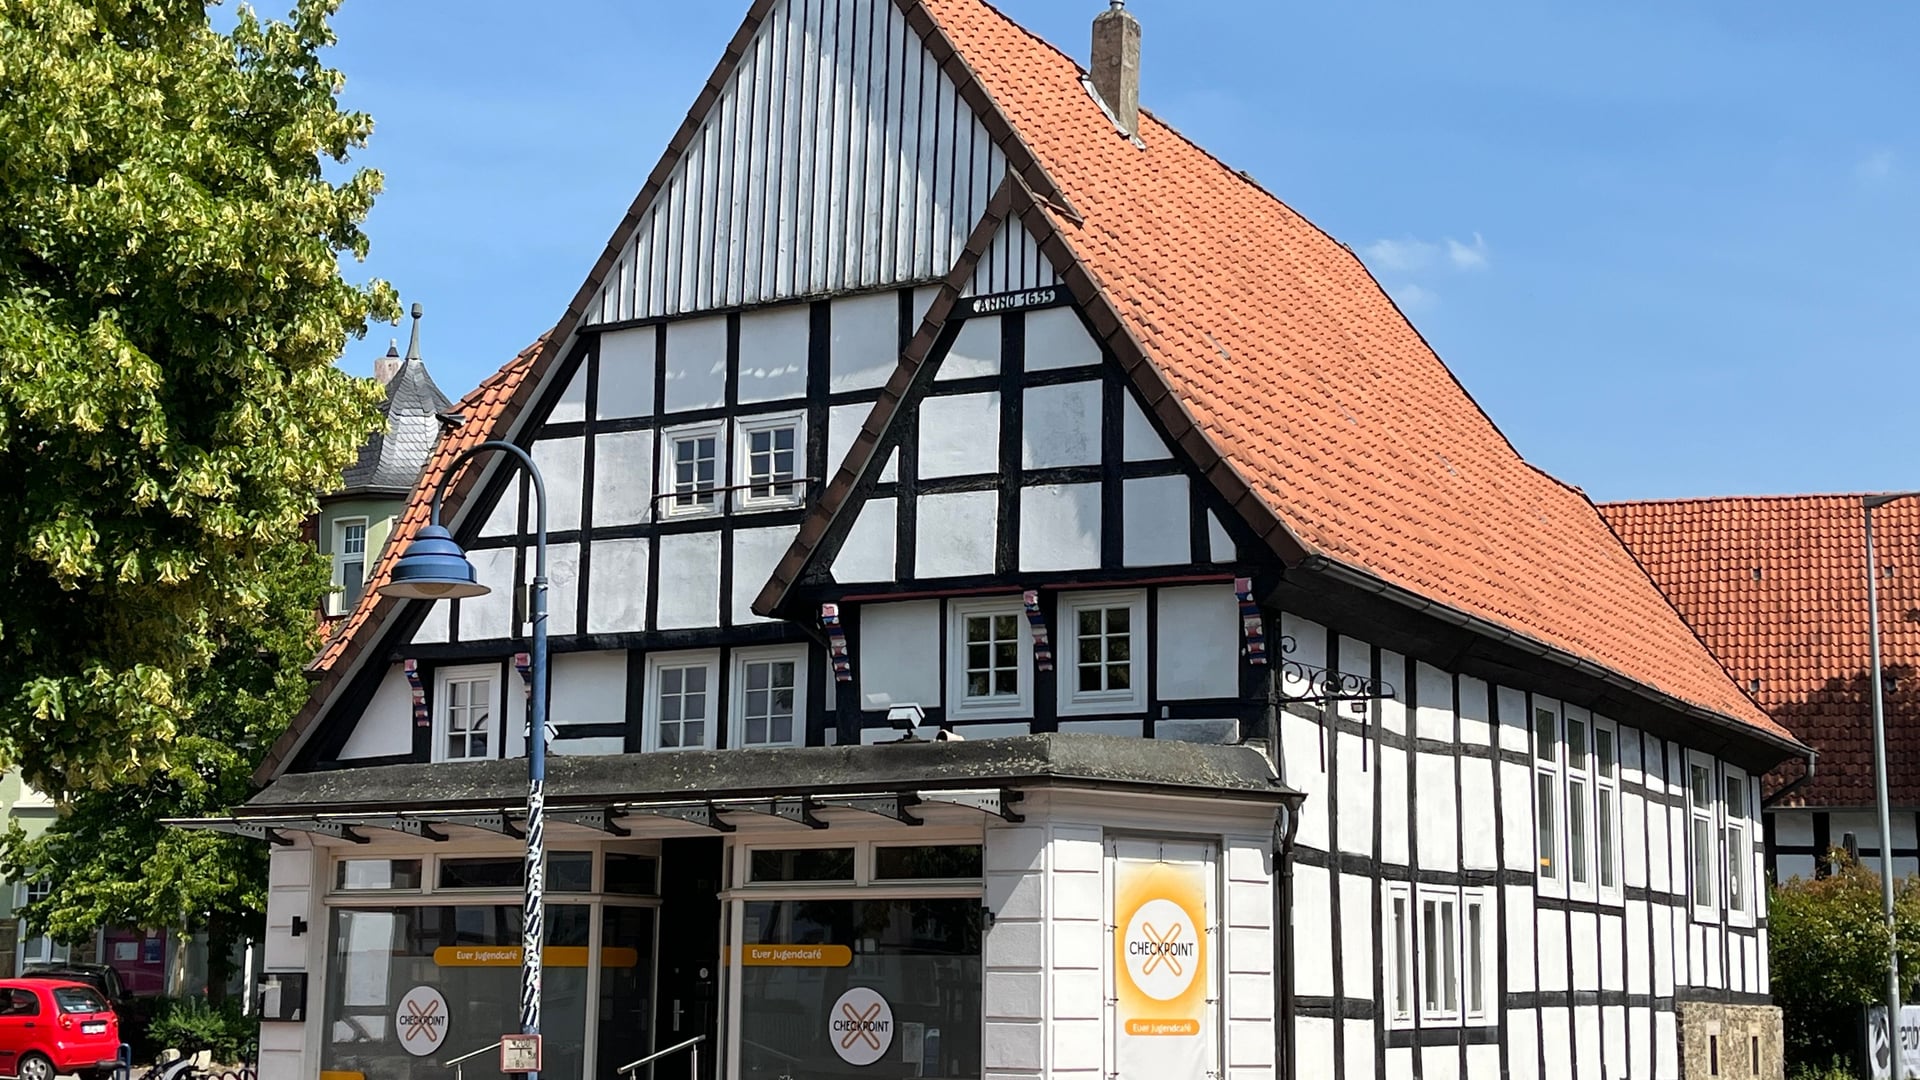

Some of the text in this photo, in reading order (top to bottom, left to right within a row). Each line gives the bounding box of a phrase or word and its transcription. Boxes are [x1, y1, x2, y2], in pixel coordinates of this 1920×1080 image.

[978, 289, 1054, 313] ANNO 1655
[1129, 941, 1194, 956] CHECKPOINT
[456, 950, 518, 961] Euer Jugendcafé
[751, 949, 822, 960] Euer Jugendcafé
[399, 1016, 446, 1026] CHECKPOINT
[833, 1020, 890, 1032] CHECKPOINT
[1132, 1023, 1149, 1032] Euer
[1901, 1017, 1920, 1050] enb
